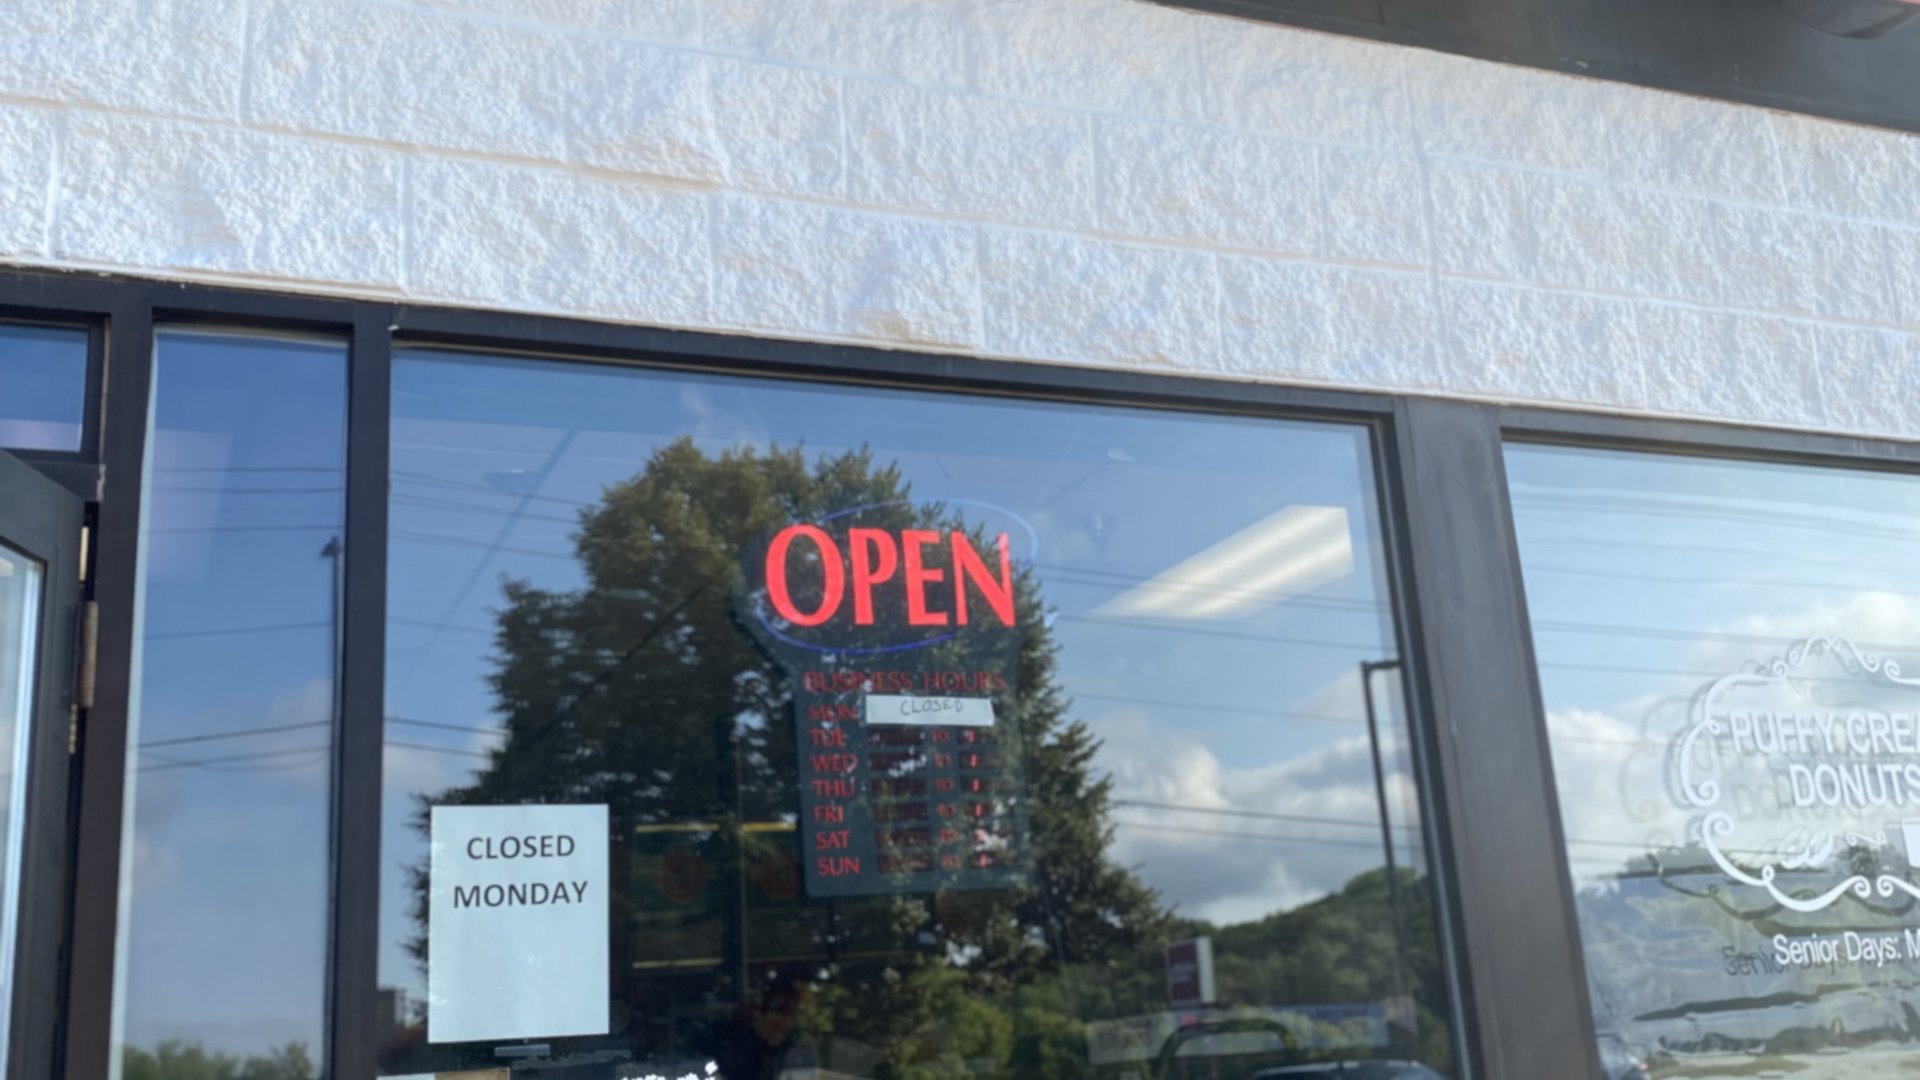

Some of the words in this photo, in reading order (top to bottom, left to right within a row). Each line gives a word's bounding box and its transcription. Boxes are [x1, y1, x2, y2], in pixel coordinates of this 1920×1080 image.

[765, 523, 1016, 627] OPEN
[804, 671, 913, 693] BUSINESS
[924, 671, 1007, 692] HOURS
[900, 699, 964, 716] CLOSED
[809, 728, 845, 747] TUE
[1729, 711, 1834, 754] PUFFY
[1846, 711, 1920, 754] CRE
[811, 753, 858, 773] WED
[813, 778, 855, 797] THU
[1789, 763, 1920, 806] DONUTS
[814, 805, 844, 824] FRI
[466, 835, 575, 860] CLOSED
[815, 829, 850, 850] SAT
[817, 856, 860, 877] SUN
[453, 881, 588, 909] MONDAY
[1773, 933, 1839, 965] Senior
[1843, 931, 1902, 968] Days:
